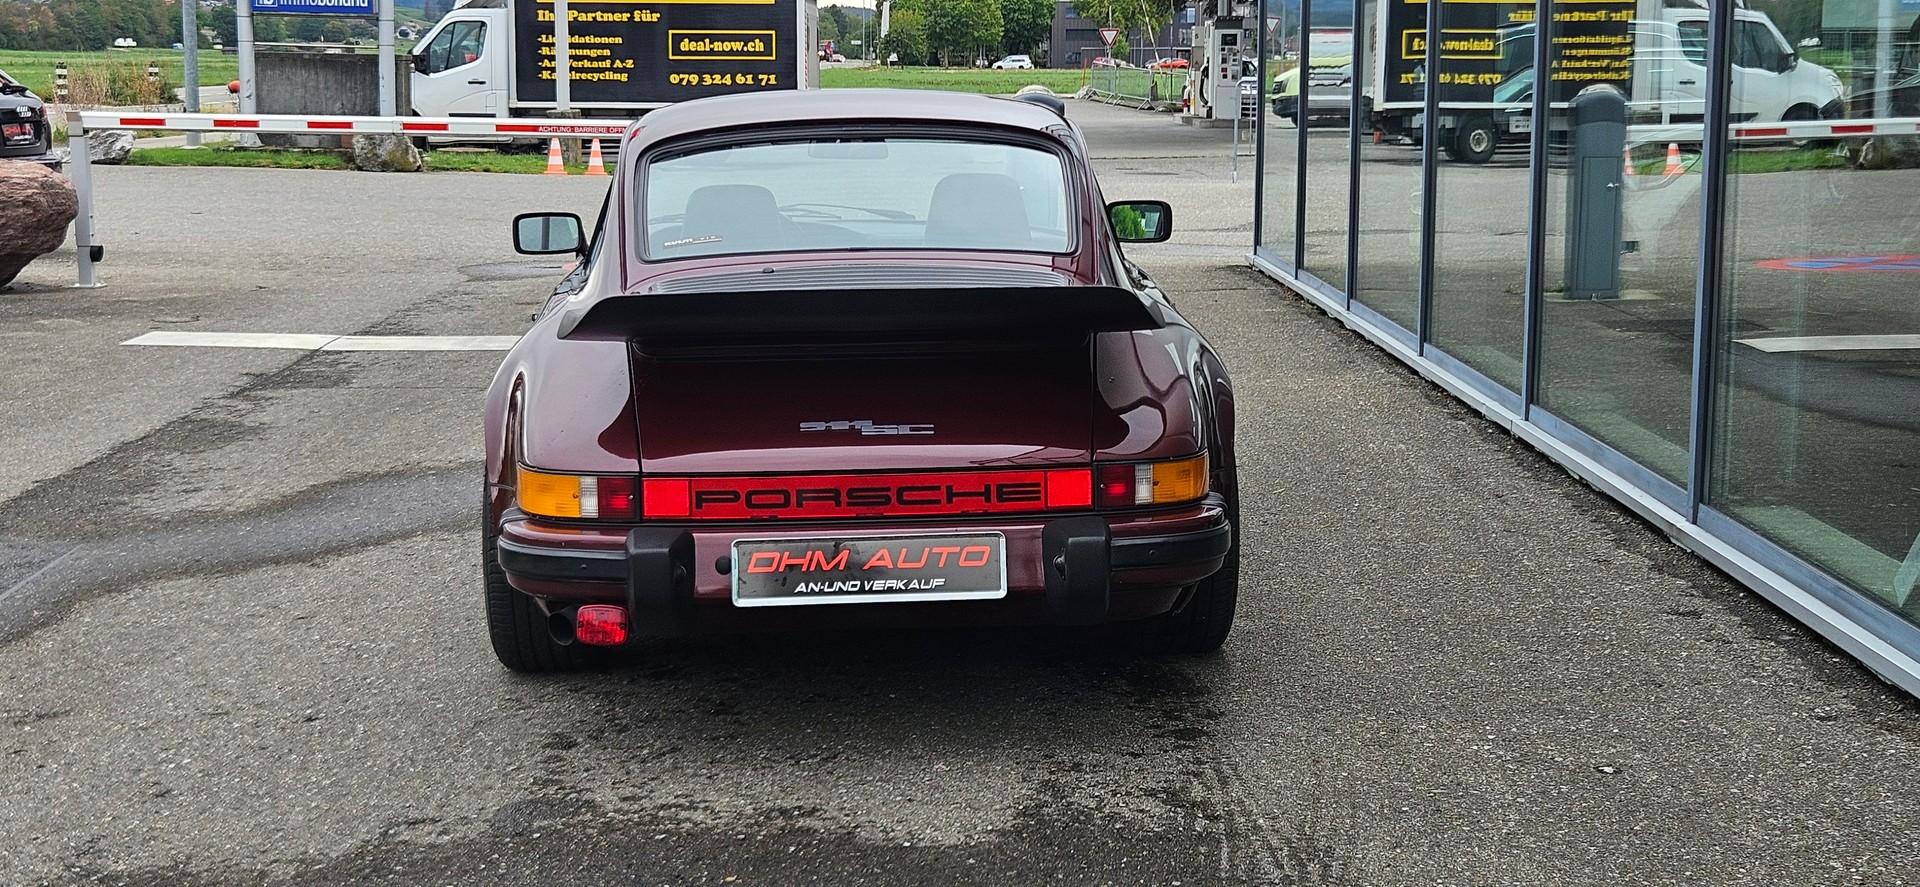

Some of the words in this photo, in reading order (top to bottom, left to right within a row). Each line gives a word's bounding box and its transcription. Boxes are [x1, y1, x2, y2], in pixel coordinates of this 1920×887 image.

[537, 10, 555, 21] Ih
[567, 10, 631, 22] Partner
[633, 10, 660, 22] für
[537, 34, 623, 44] -Liidationen
[680, 38, 765, 52] deal-now.ch
[537, 46, 611, 57] -Rämungen
[613, 59, 635, 69] A-Z
[537, 70, 629, 82] -Kaelrecycling
[669, 73, 699, 86] 079
[702, 73, 732, 86] 324
[735, 73, 754, 85] 61
[758, 74, 777, 86] 71
[574, 126, 607, 134] BARRIERE
[695, 482, 1042, 510] PORSCHE
[747, 549, 850, 574] DHM
[863, 545, 991, 570] AUTO
[794, 580, 861, 593] AN-UND
[863, 578, 945, 592] VERKAUF
